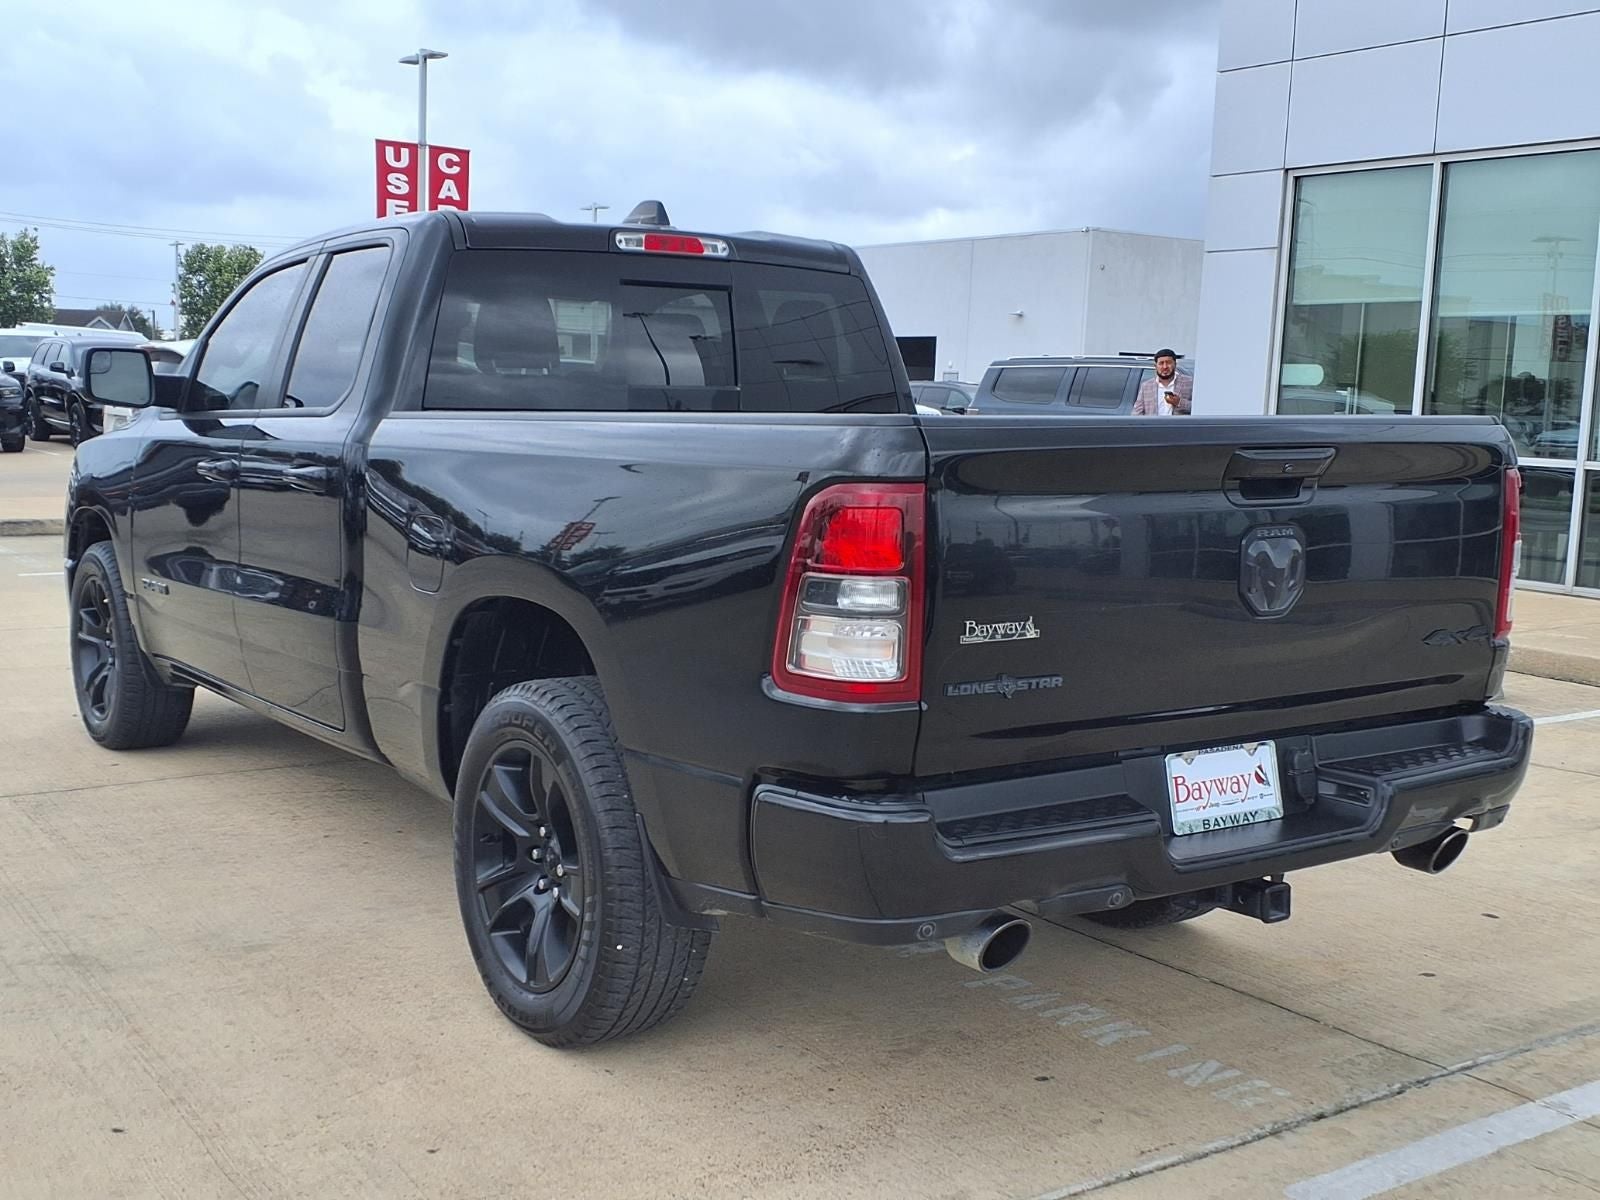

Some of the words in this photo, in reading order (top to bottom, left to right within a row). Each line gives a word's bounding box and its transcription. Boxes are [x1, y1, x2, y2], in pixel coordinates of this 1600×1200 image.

[1257, 528, 1294, 537] RAM
[964, 620, 1024, 641] Bayway
[946, 683, 997, 696] LONE
[1017, 676, 1063, 690] STAR
[1198, 744, 1244, 755] PASADENA
[1172, 772, 1252, 810] Bayway
[1202, 810, 1259, 830] BAYWAY
